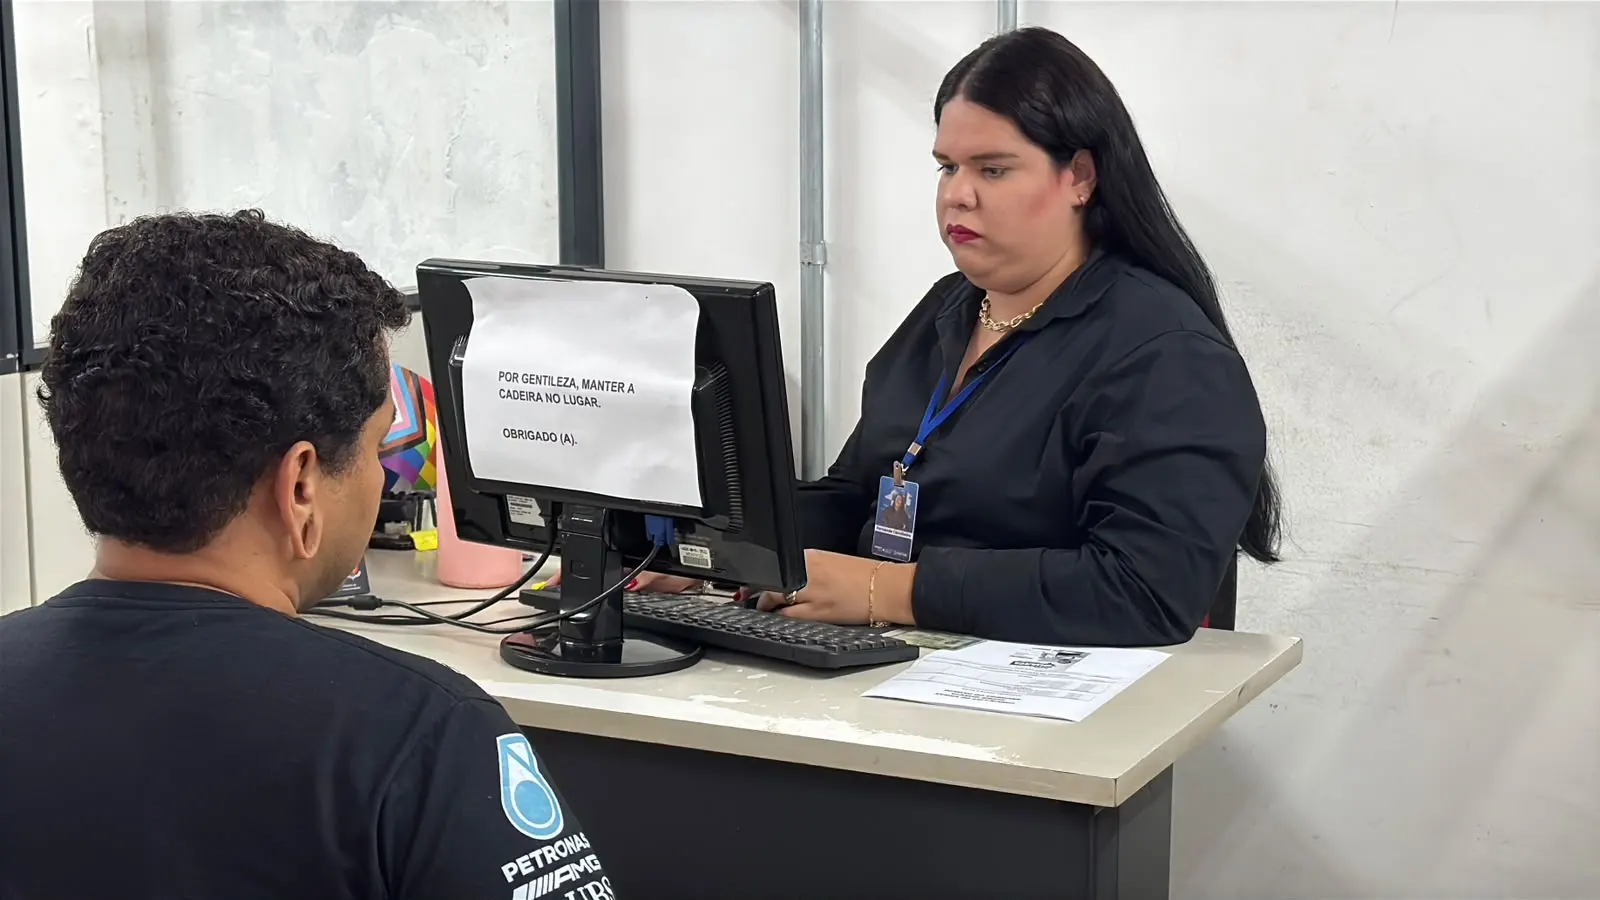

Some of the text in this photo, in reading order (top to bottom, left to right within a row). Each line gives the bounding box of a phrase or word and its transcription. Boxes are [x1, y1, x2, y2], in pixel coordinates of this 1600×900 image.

[498, 371, 635, 394] POR GENTILEZA, MANTER A
[499, 388, 601, 407] CADEIRA NO LUGAR.
[503, 428, 578, 446] OBRIGADO (A).
[501, 832, 591, 883] PETRONAS
[554, 854, 602, 889] AMG
